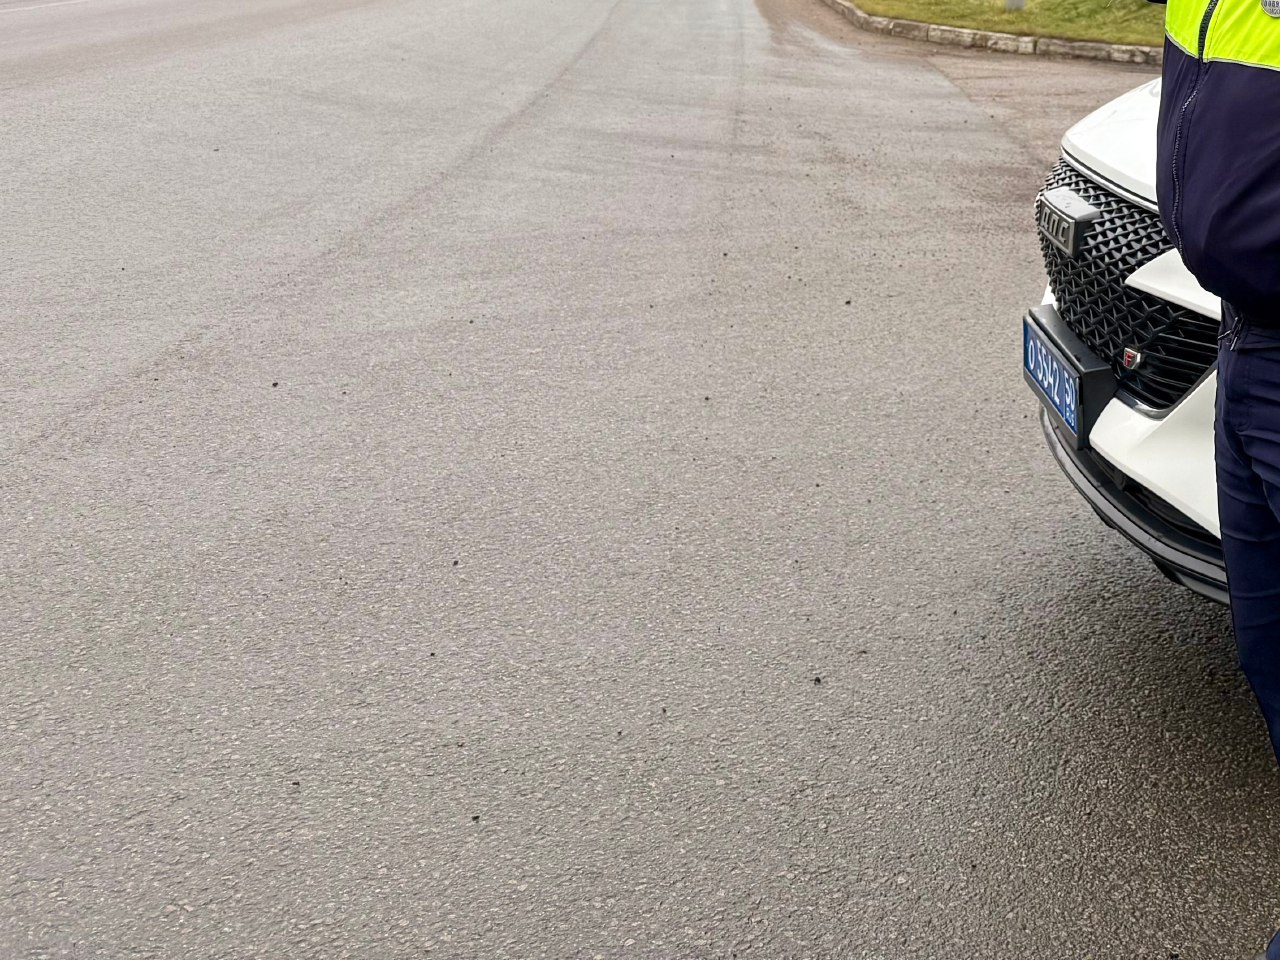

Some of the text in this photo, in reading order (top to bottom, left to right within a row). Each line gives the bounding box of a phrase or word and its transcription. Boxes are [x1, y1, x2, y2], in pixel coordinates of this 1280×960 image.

[1040, 206, 1070, 244] ДПС
[1036, 339, 1060, 406] 5542
[1063, 369, 1075, 411] 50
